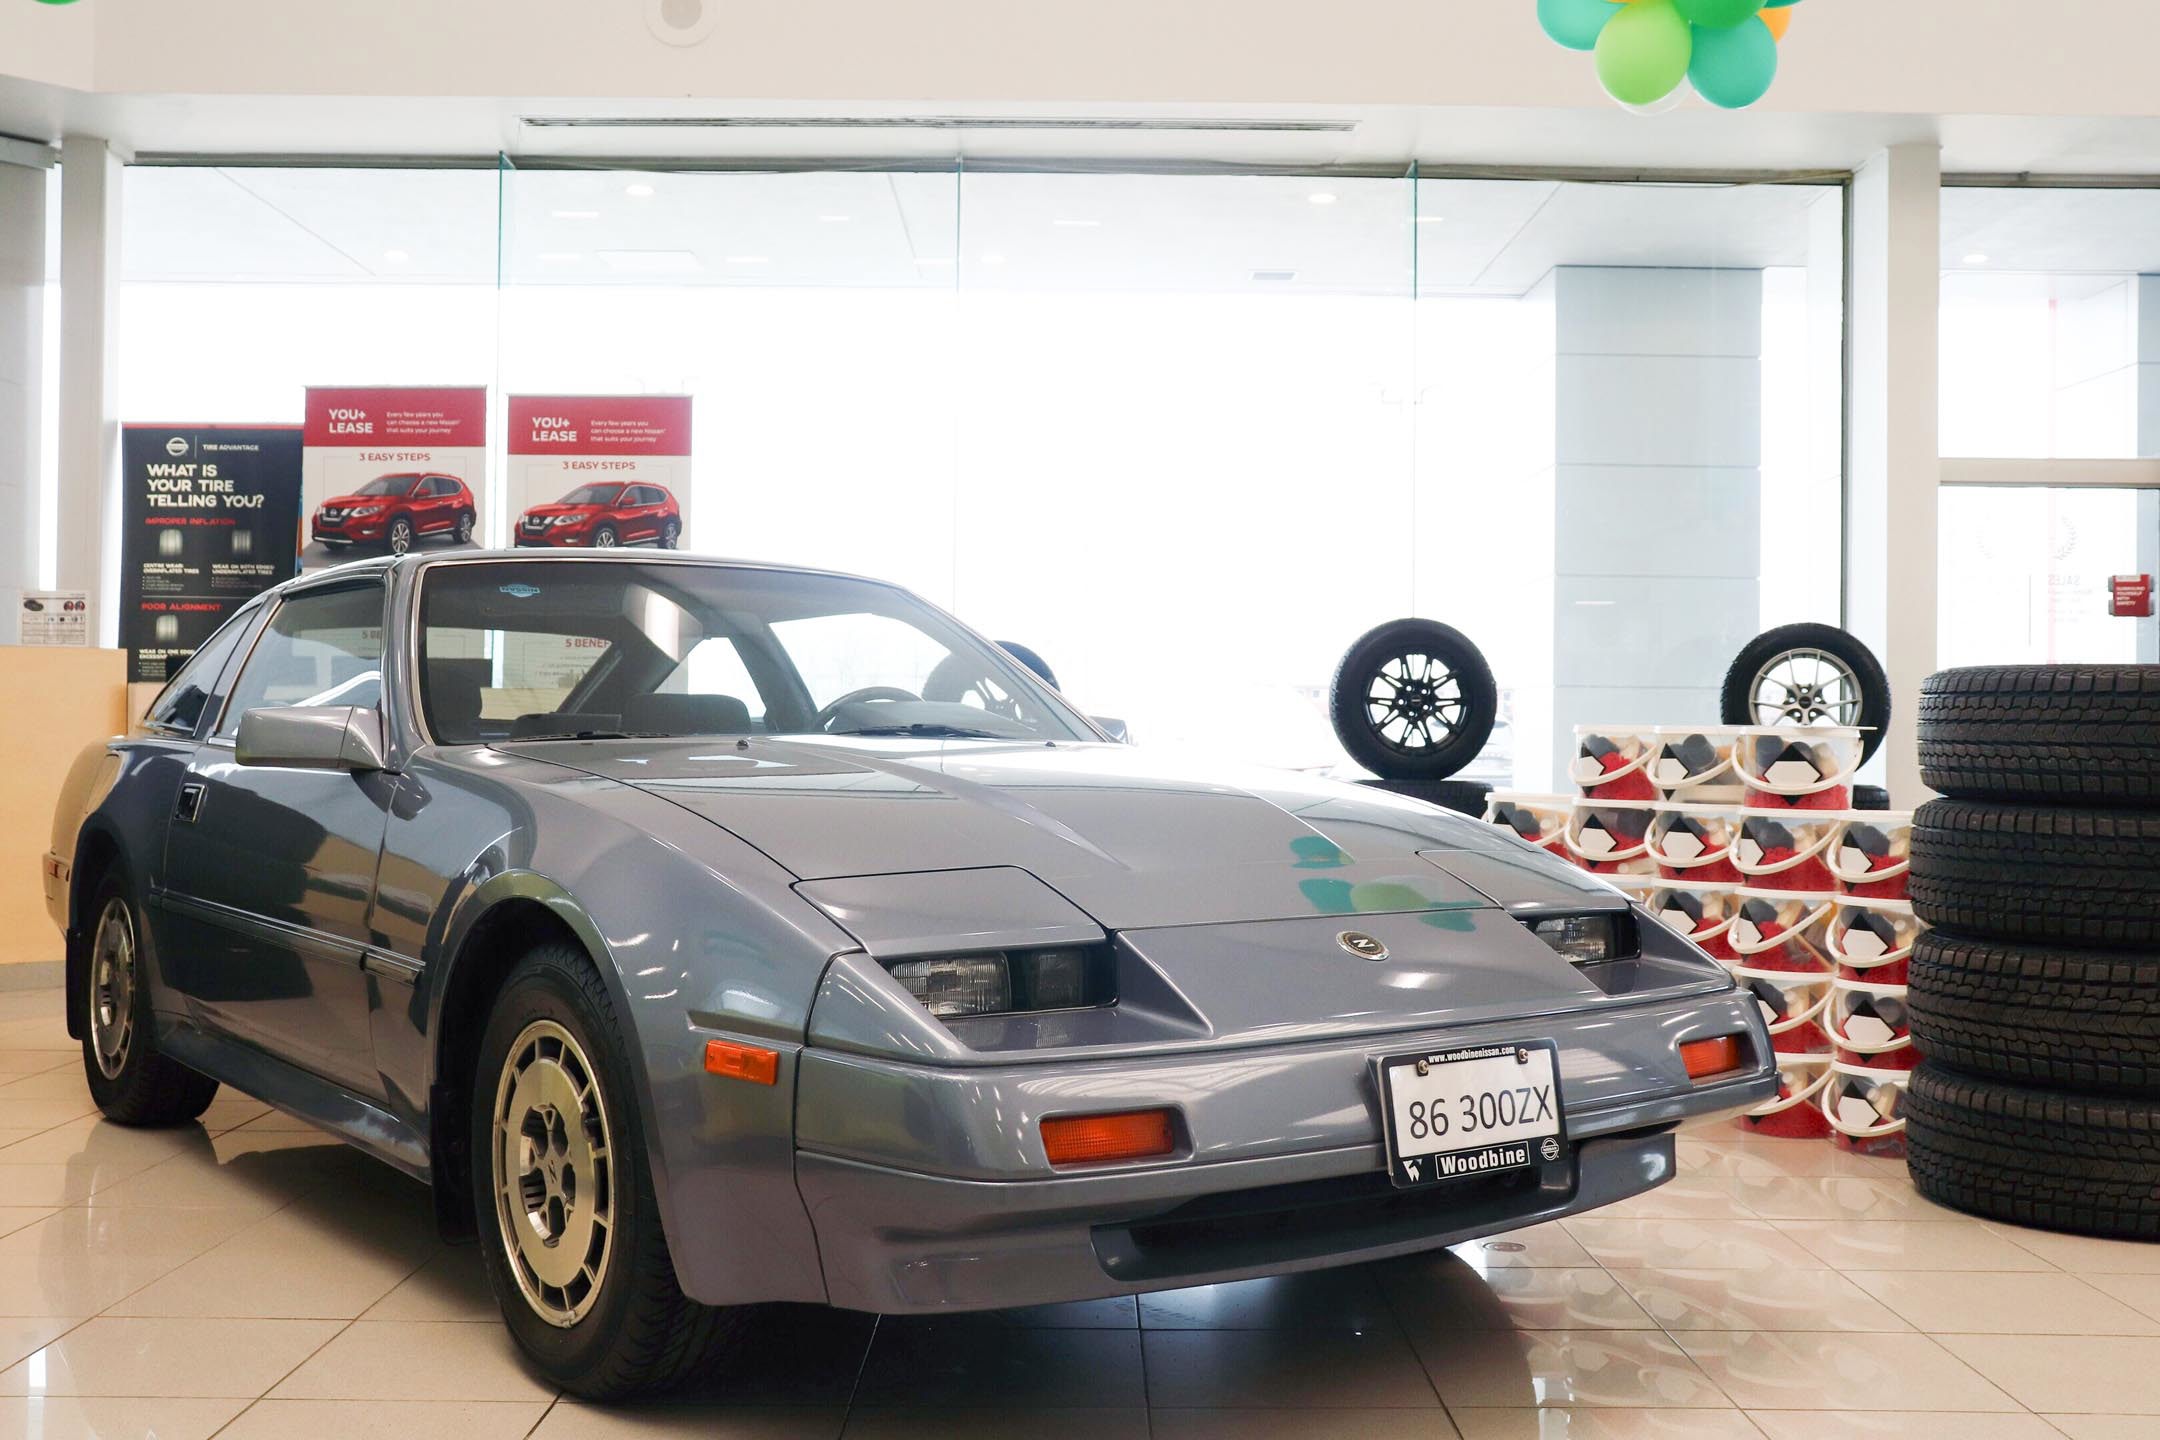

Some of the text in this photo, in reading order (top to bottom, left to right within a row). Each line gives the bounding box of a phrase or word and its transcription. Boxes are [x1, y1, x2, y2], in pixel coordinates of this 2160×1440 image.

[329, 422, 374, 434] LEASE
[532, 431, 577, 442] LEASE
[360, 453, 431, 461] 3 EASY STEPS
[147, 464, 218, 477] WHAT IS
[562, 461, 636, 470] 3 EASY STEPS
[147, 479, 234, 492] YOUR TIRE
[146, 494, 265, 508] TELLING YOU?
[145, 517, 187, 525] IMPROPER
[141, 603, 222, 611] POOR ALIGNMENT
[565, 638, 572, 647] 5
[1428, 1046, 1516, 1063] www.woodbinenissan.com
[1409, 1084, 1553, 1140] 86 300ZX
[1440, 1148, 1526, 1175] Woodbine
